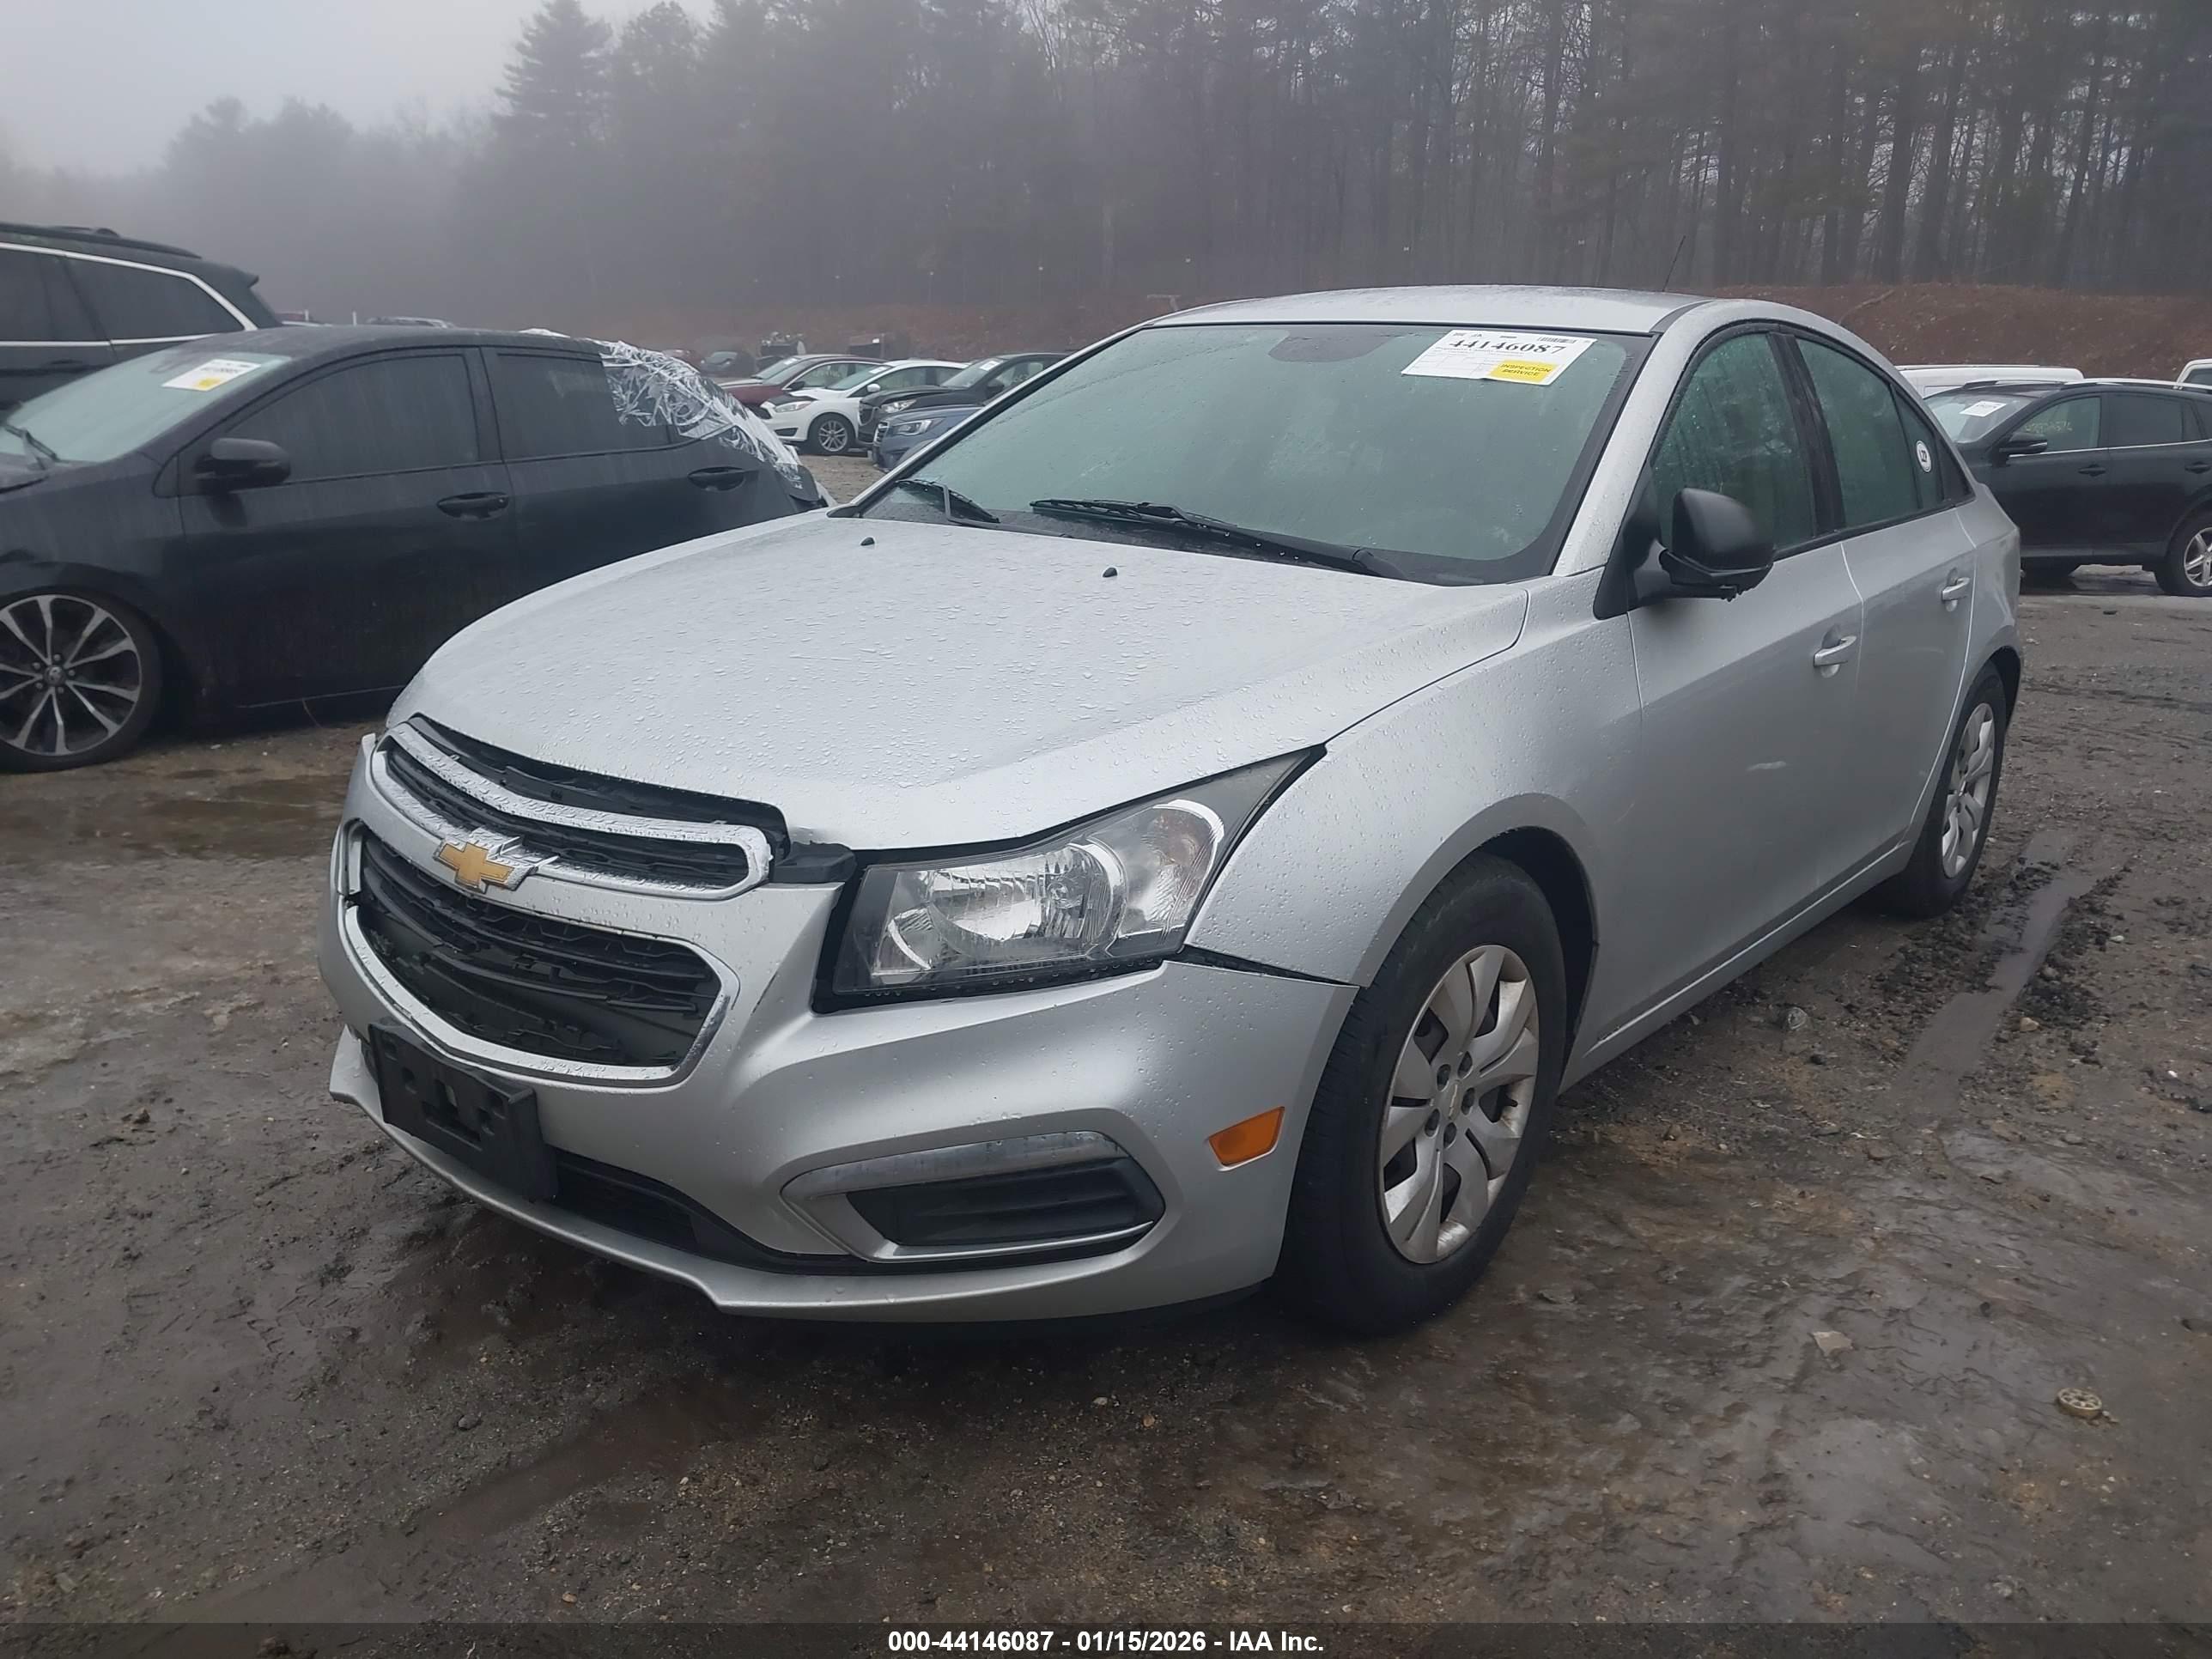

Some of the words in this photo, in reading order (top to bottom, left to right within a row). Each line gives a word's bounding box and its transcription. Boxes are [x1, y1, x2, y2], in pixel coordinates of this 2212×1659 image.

[1449, 339, 1567, 355] 44146087
[1500, 363, 1552, 374] INSPECTION
[1502, 368, 1540, 377] SERVICE
